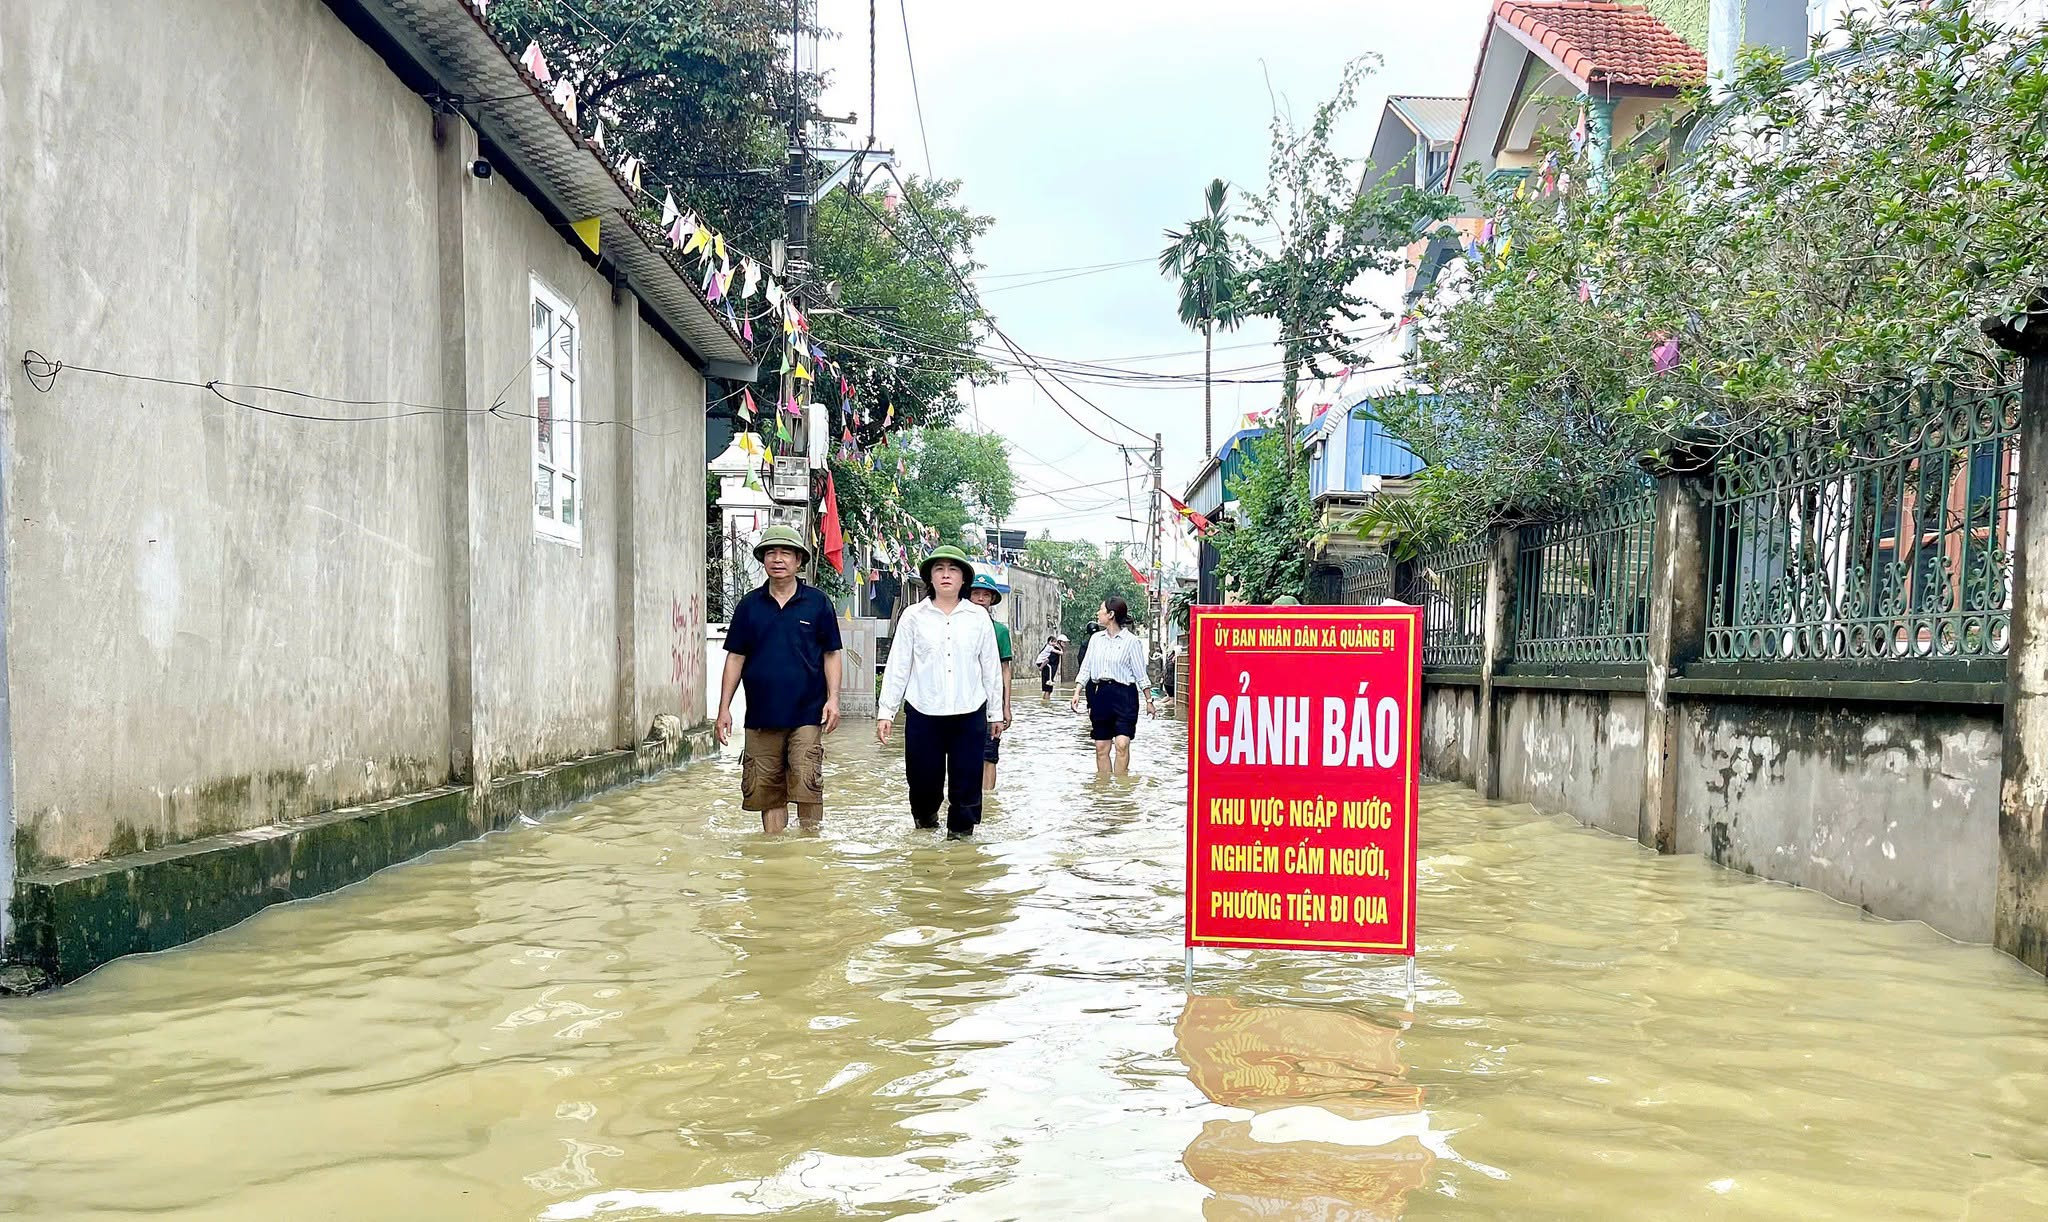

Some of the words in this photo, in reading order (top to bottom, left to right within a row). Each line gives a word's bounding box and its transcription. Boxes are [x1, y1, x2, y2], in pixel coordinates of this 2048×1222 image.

[1215, 623, 1230, 647] ỦY
[1232, 628, 1256, 647] BAN
[1259, 625, 1291, 647] NHÂN
[1294, 625, 1318, 647] DÂN
[1321, 626, 1337, 647] XÃ
[1340, 624, 1380, 649] QUẢNG
[1382, 629, 1395, 652] BỊ
[1206, 671, 1310, 765] CẢNH
[1322, 681, 1400, 769] BÁO
[1210, 798, 1245, 826] KHU
[1250, 797, 1285, 832] VỰC
[1289, 795, 1338, 834] NGẬP
[1343, 796, 1392, 830] NƯỚC
[1211, 840, 1279, 873] NGHIÊM
[1284, 838, 1324, 875] CẤM
[1330, 843, 1390, 880] NGƯỜI,
[1211, 889, 1281, 920] PHƯƠNG
[1286, 888, 1325, 927] TIỆN
[1330, 896, 1348, 922] ĐI
[1353, 896, 1388, 927] QUA
